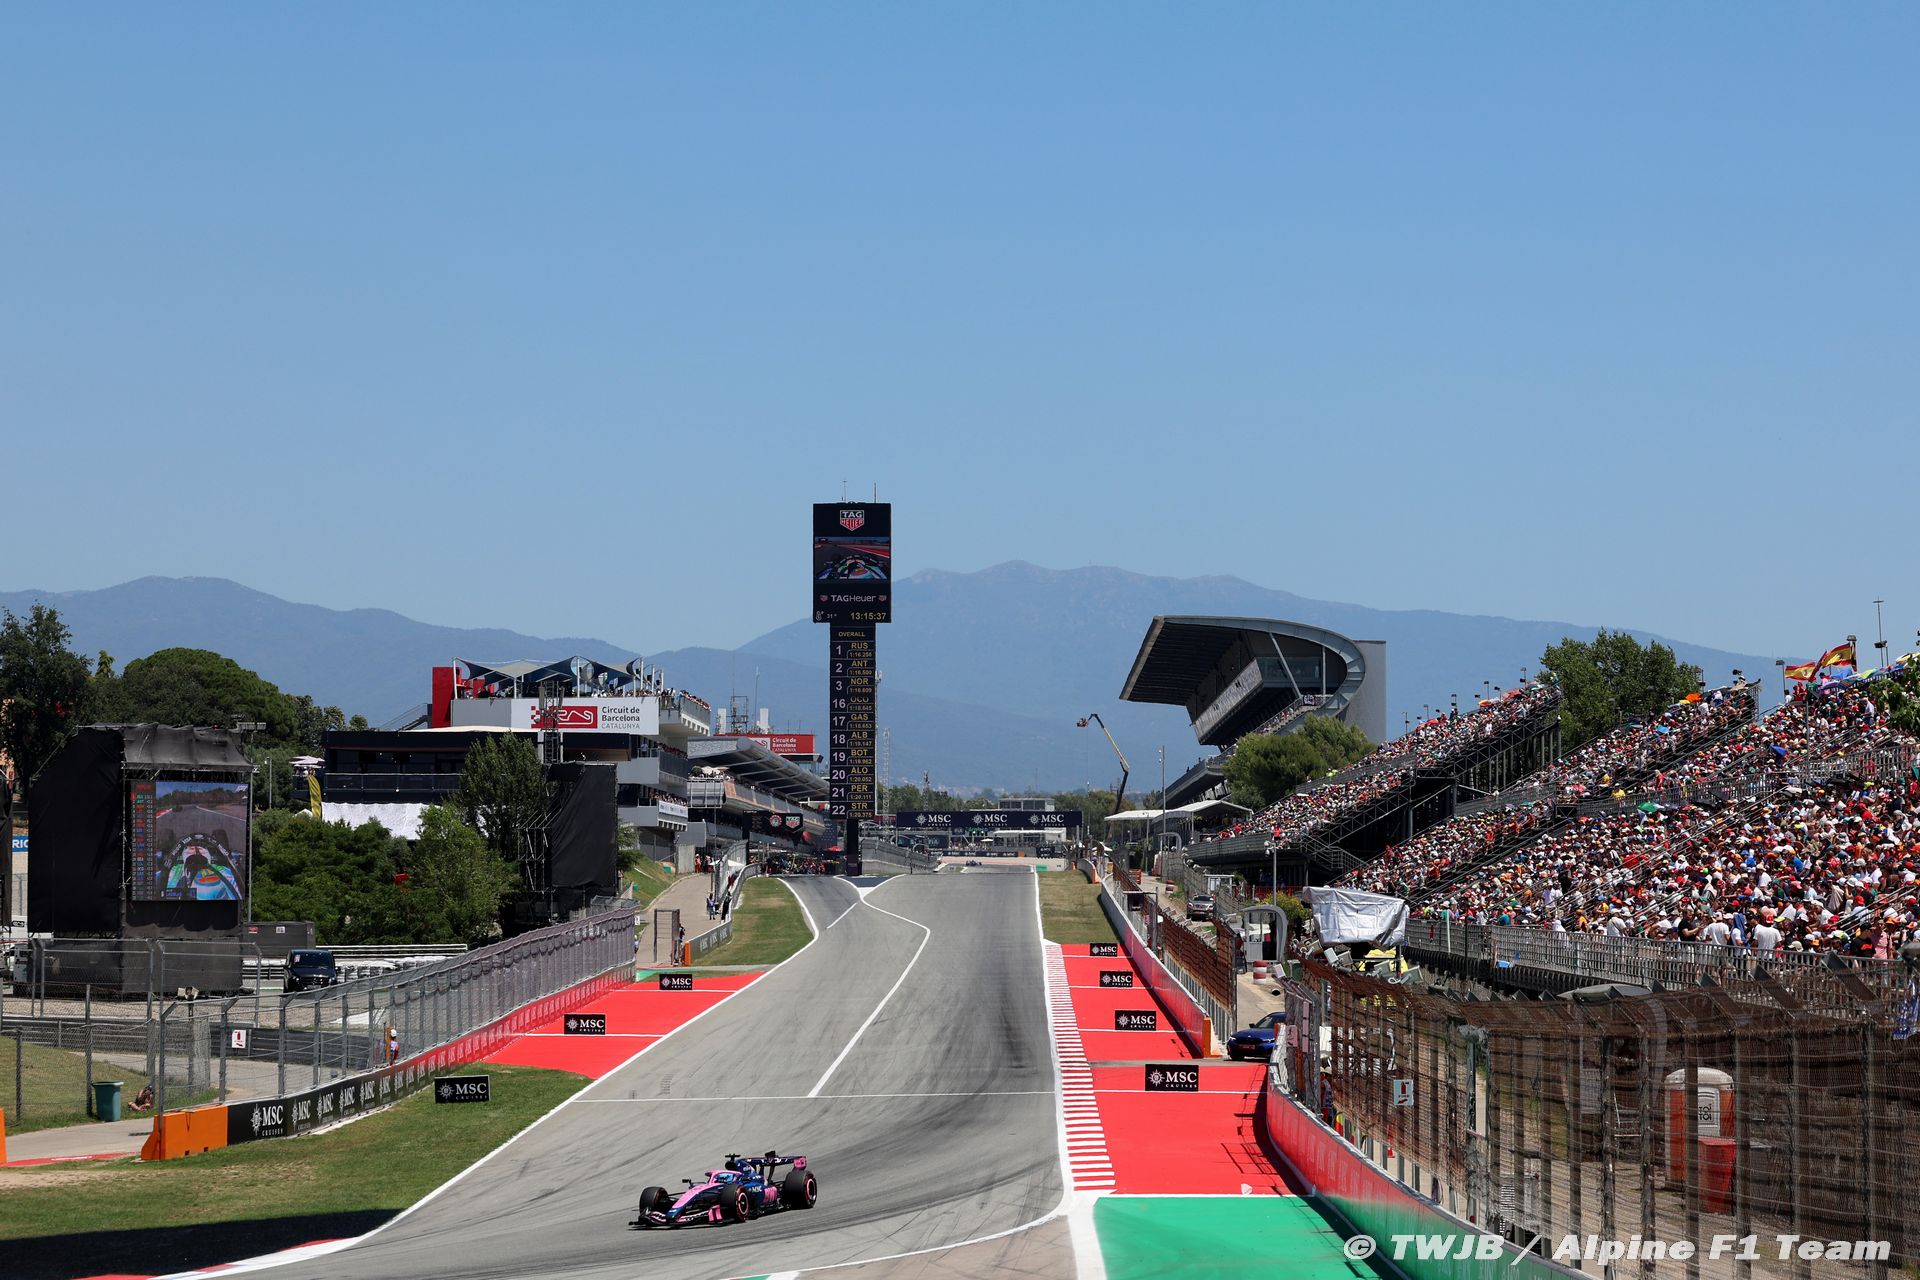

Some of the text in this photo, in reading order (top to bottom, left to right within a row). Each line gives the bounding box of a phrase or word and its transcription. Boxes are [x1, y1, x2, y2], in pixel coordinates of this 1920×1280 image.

[836, 645, 841, 654] 1
[836, 663, 842, 672] 2
[836, 681, 842, 691] 3
[833, 699, 846, 708] 16
[833, 716, 845, 726] 17
[833, 734, 845, 744] 18
[833, 752, 845, 762] 19
[832, 770, 845, 779] 20
[832, 788, 845, 797] 21
[832, 806, 845, 814] 22
[580, 1020, 604, 1028] MSC
[1131, 1016, 1155, 1024] MSC
[1166, 1072, 1197, 1082] MSC
[456, 1083, 487, 1094] MSC
[298, 1100, 311, 1120] MSC
[262, 1106, 283, 1126] MSC
